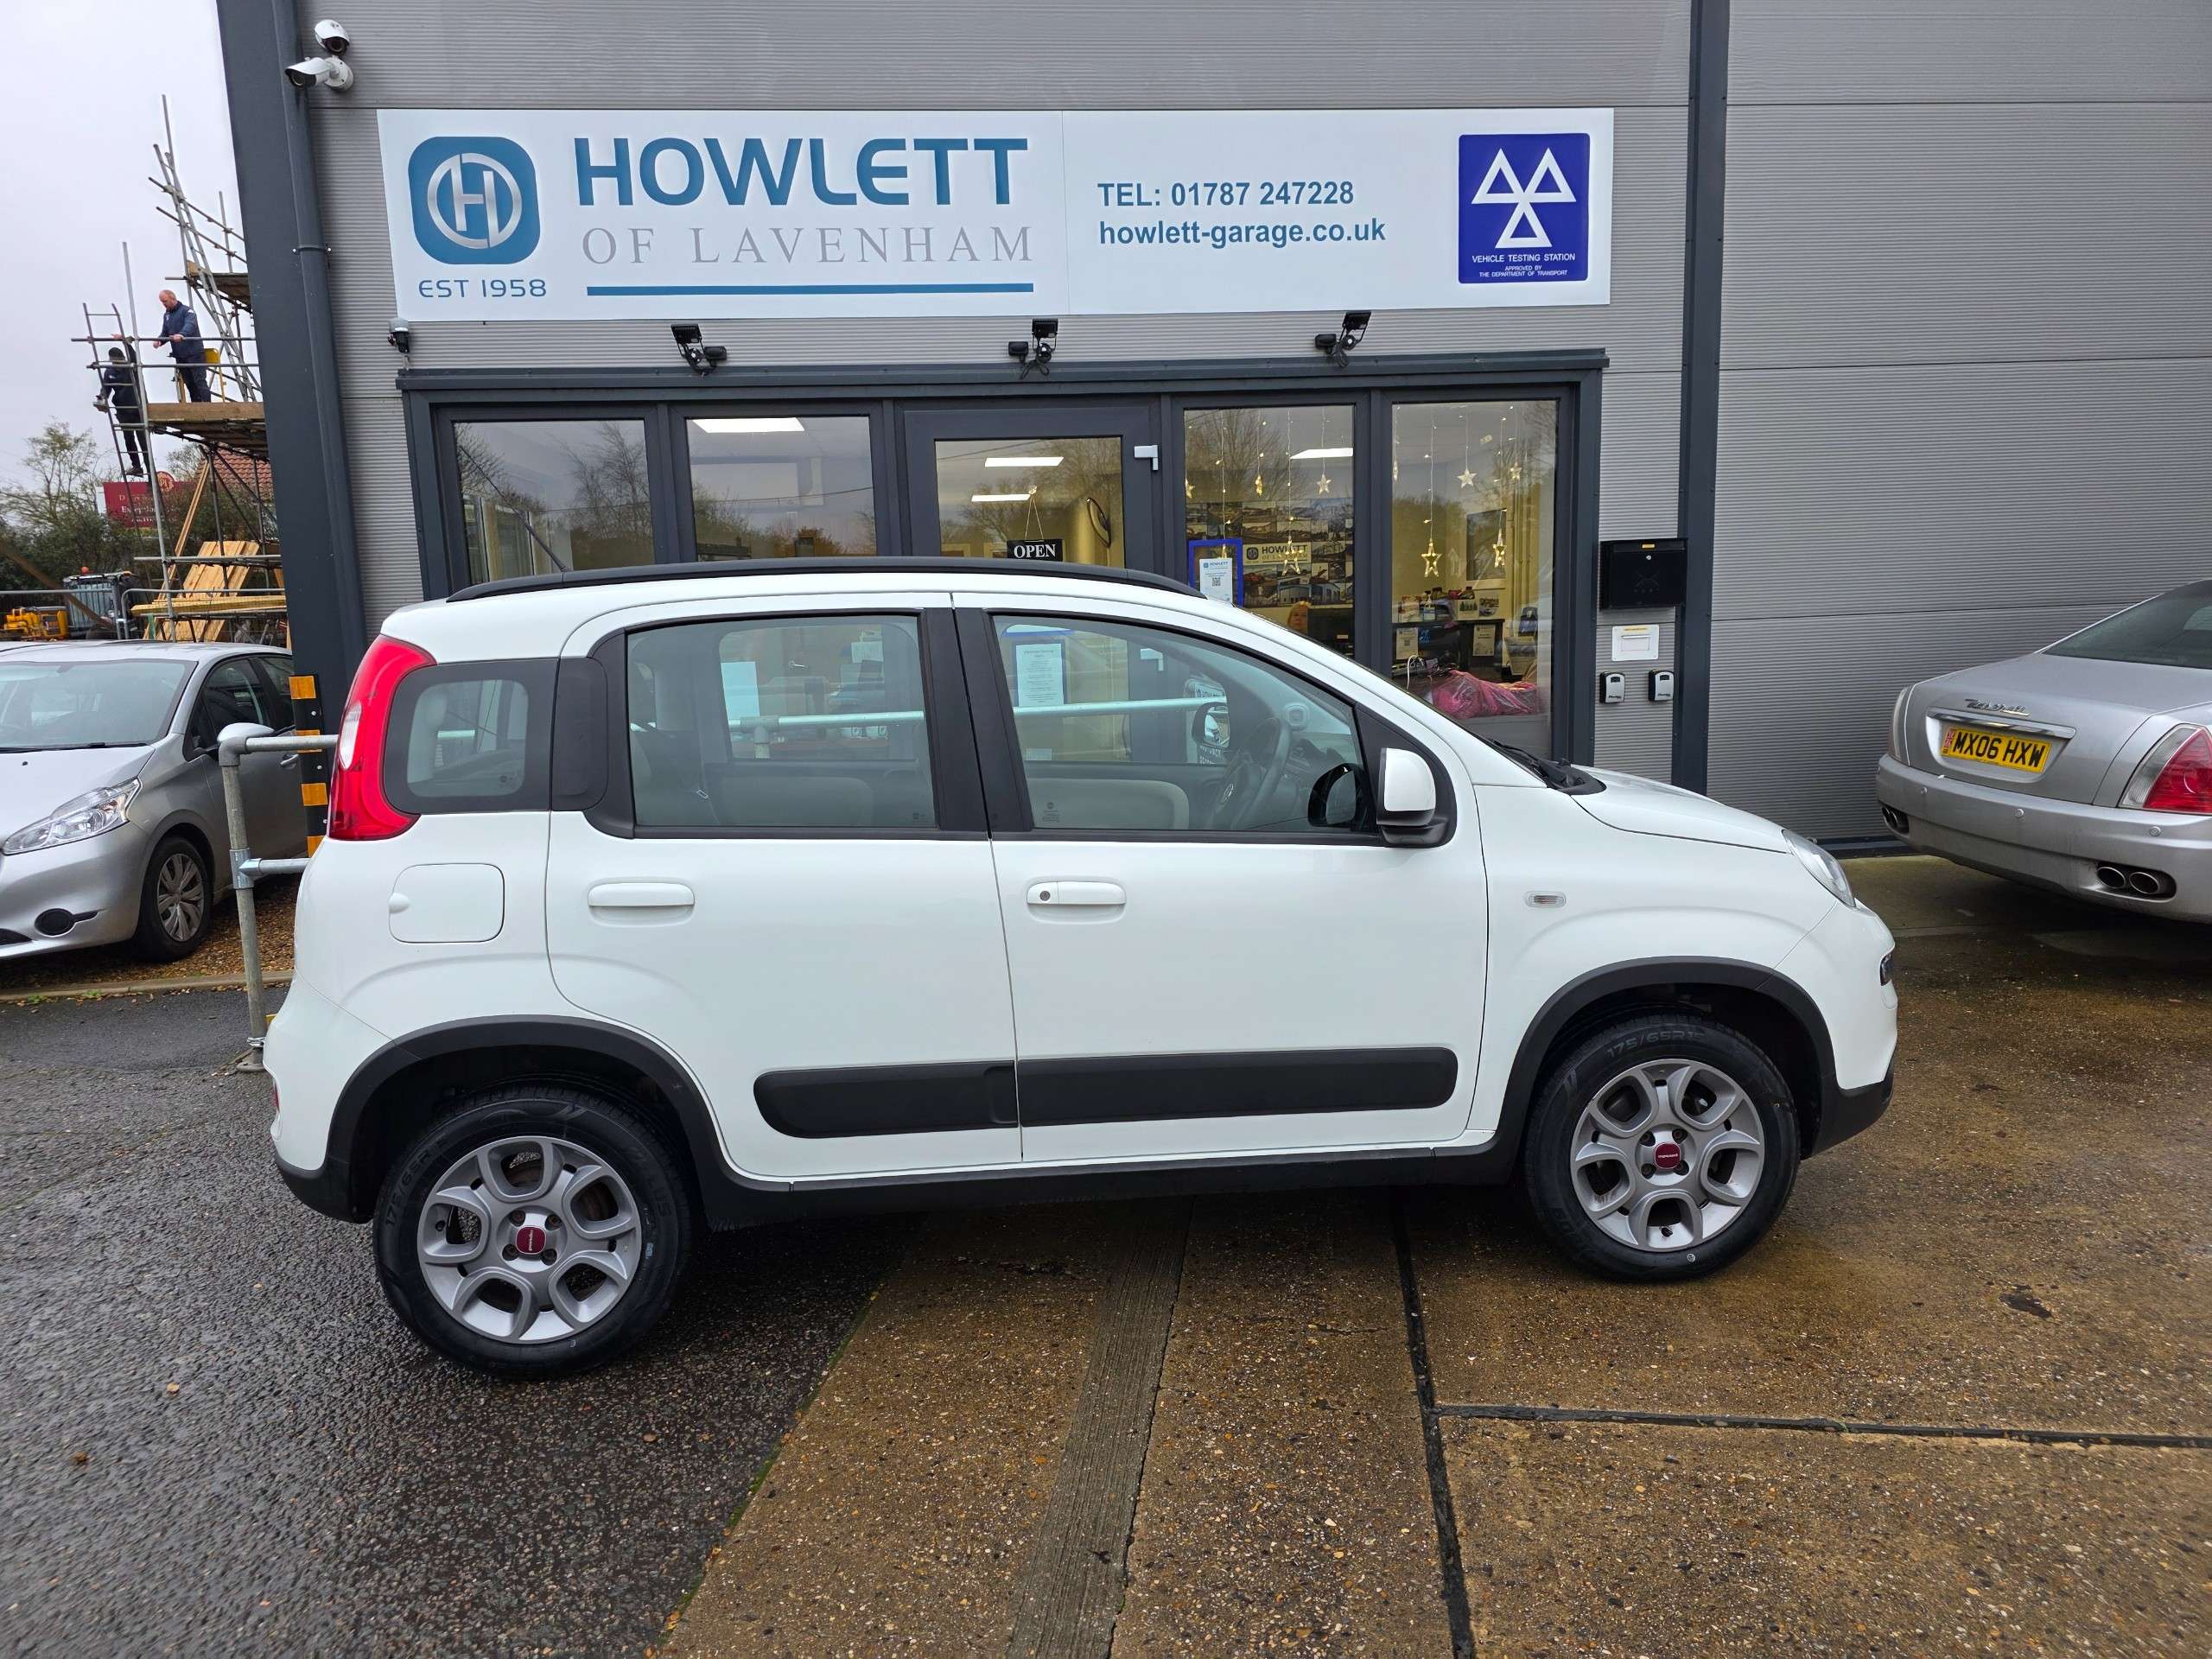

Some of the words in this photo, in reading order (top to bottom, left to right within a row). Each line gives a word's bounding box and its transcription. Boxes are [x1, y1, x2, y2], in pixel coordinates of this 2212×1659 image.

[574, 137, 1028, 207] HOWLETT
[1097, 182, 1160, 207] TEL:
[1171, 181, 1249, 207] 01787
[1259, 181, 1354, 206] 247228
[582, 227, 654, 264] OF
[688, 226, 1033, 264] LAVENHAM
[1099, 217, 1386, 250] howlett-garage.co.uk
[1508, 254, 1541, 263] TESTING
[1543, 253, 1576, 262] STATION
[418, 279, 469, 298] EST
[481, 278, 547, 298] 1958
[1014, 543, 1056, 559] OPEN
[1953, 731, 2002, 759] MX06
[2002, 739, 2046, 767] HXW
